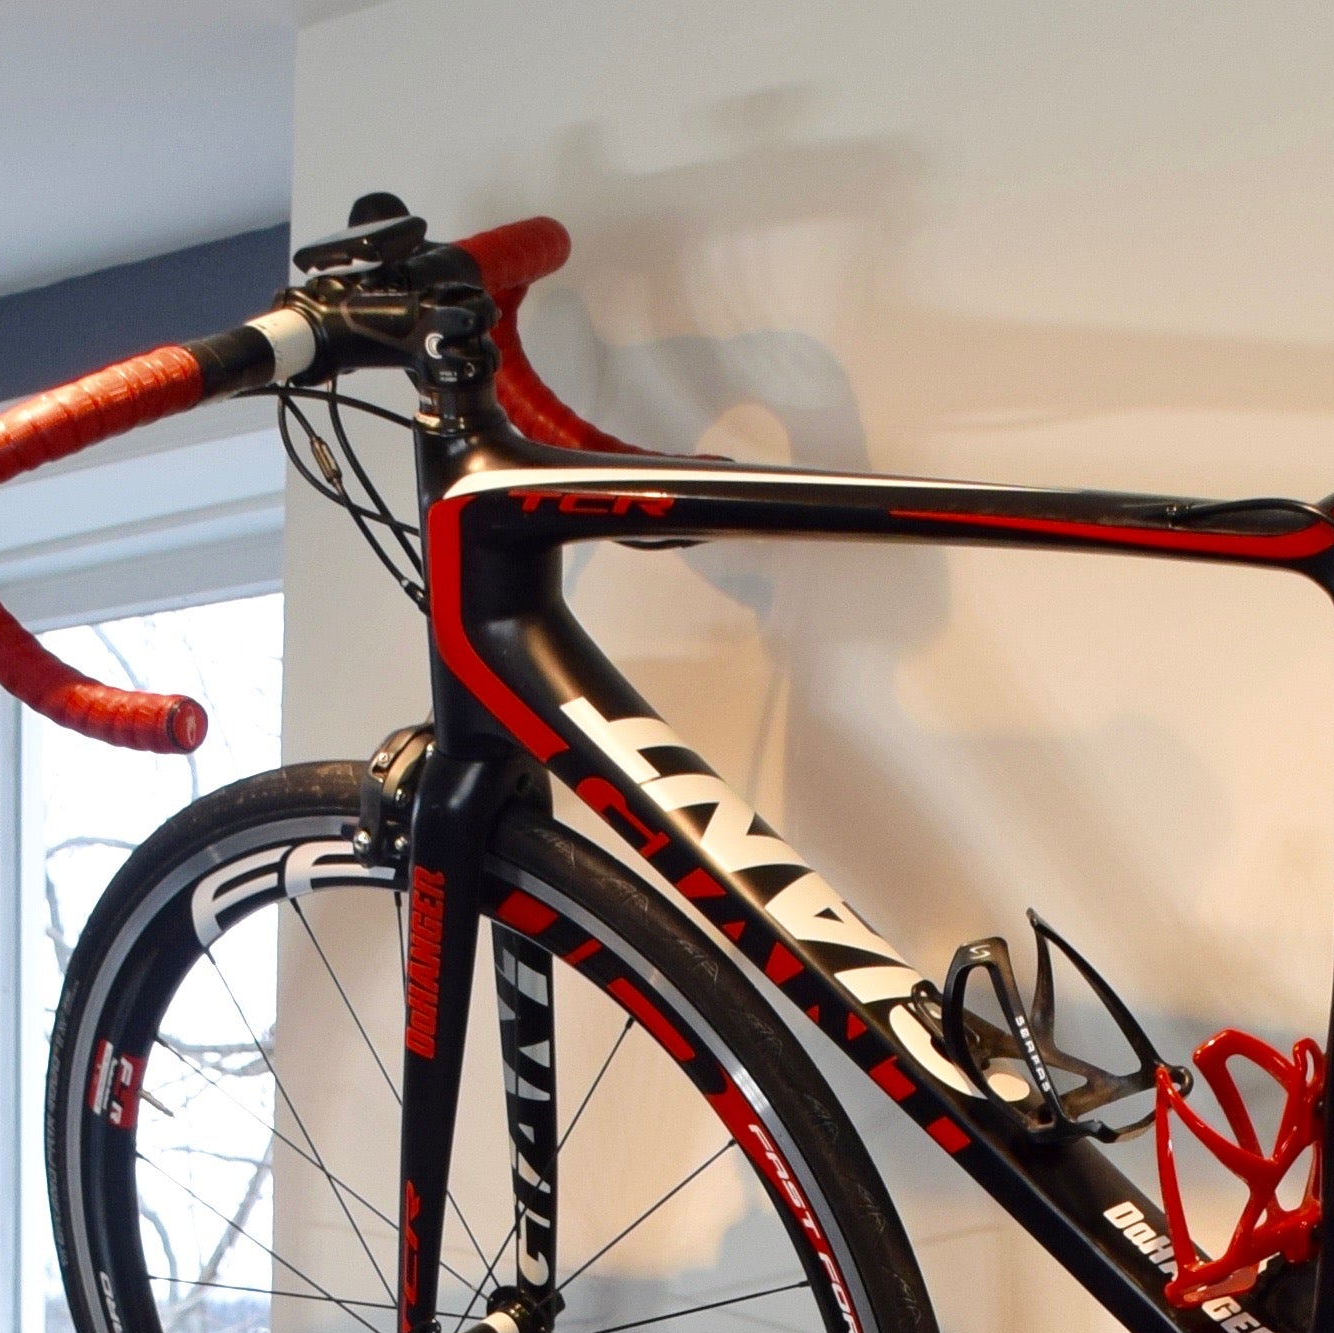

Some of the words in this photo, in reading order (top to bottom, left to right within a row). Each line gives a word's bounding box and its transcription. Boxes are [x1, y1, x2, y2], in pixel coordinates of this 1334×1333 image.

[508, 489, 675, 518] TCR
[560, 697, 1030, 1102] GIANT
[1014, 1015, 1052, 1093] SERFAS
[748, 1122, 819, 1244] FAST
